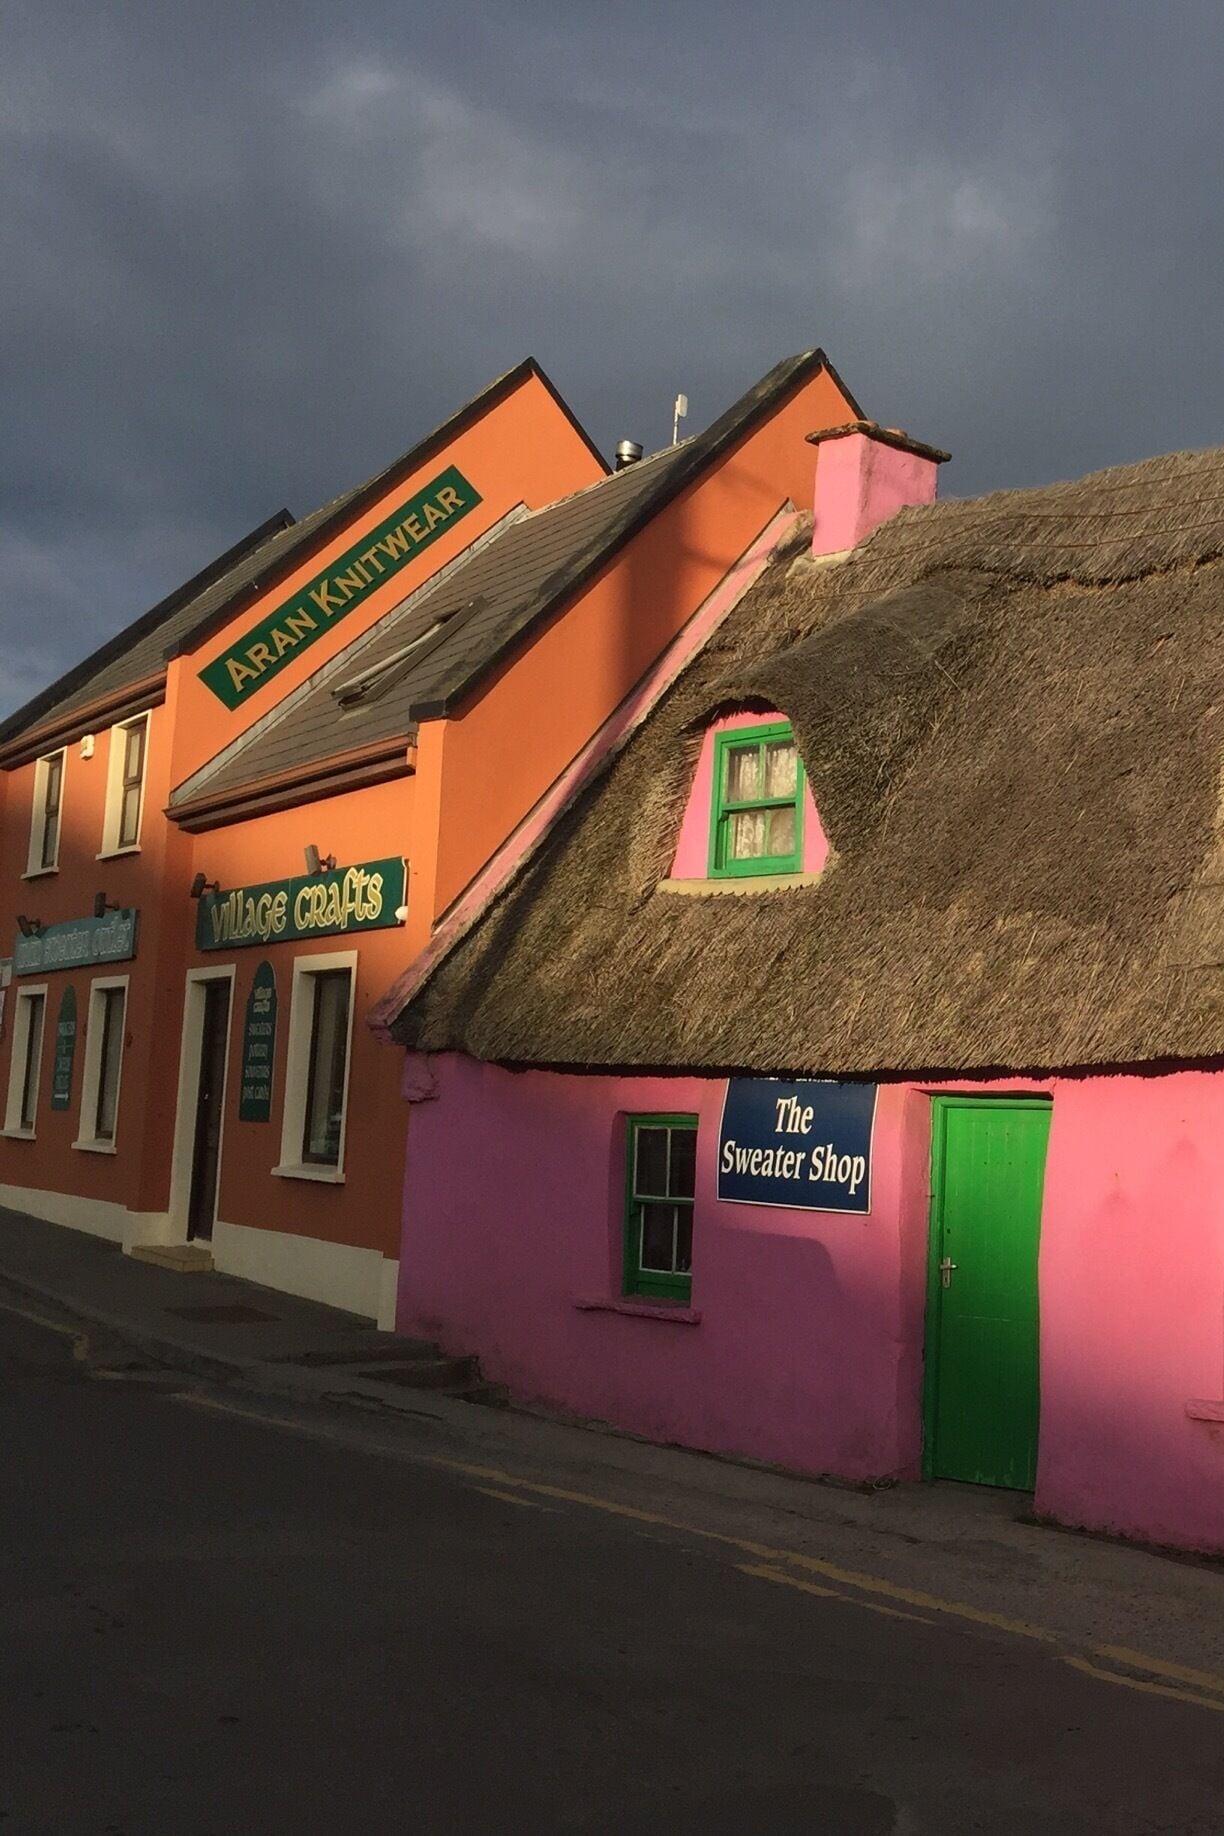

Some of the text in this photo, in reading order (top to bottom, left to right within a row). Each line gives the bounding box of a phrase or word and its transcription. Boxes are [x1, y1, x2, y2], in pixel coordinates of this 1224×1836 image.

[224, 486, 466, 693] ARAN KNITWEAR
[775, 1095, 815, 1135] The
[721, 1140, 866, 1195] Sweater Shop
